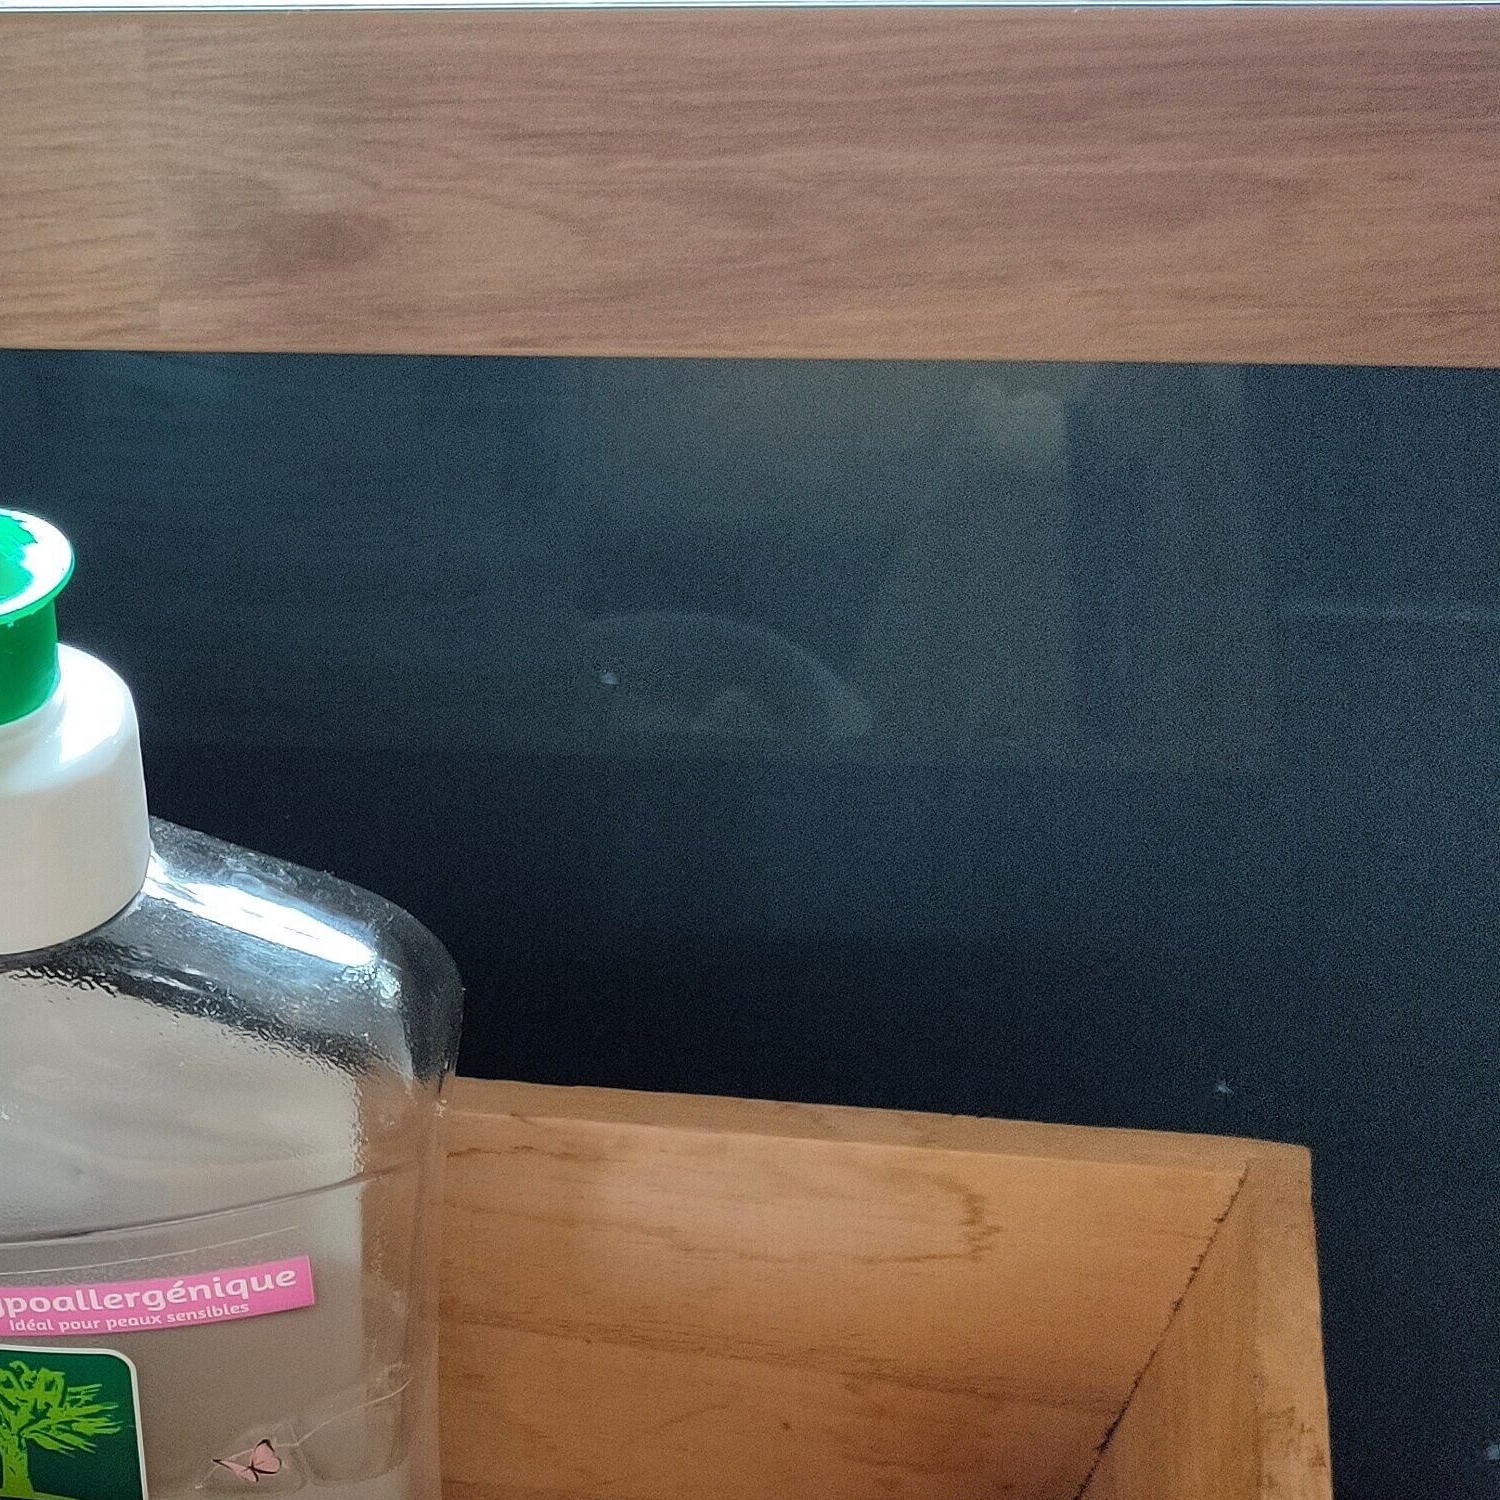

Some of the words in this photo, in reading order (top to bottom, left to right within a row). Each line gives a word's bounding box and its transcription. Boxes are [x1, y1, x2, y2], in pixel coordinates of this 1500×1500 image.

[10, 1319, 54, 1332] Idéal
[58, 1319, 101, 1333] pour
[106, 1314, 162, 1330] peaux
[167, 1303, 250, 1323] sensibles
